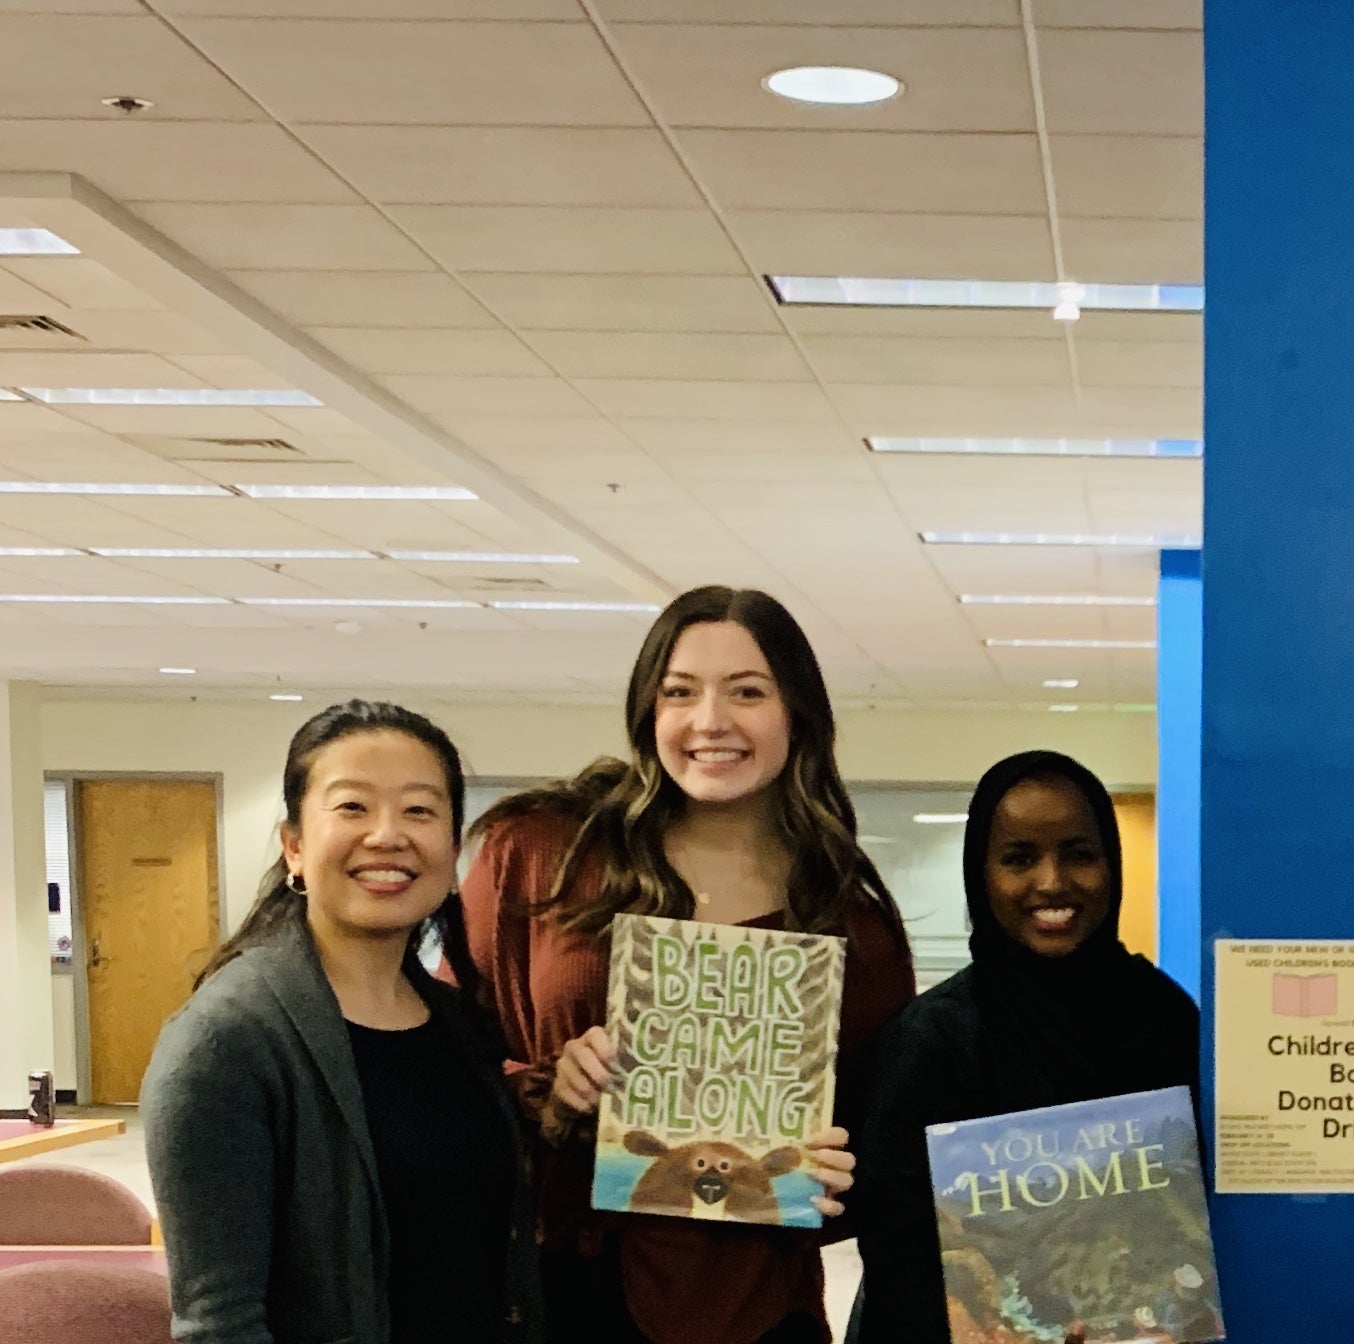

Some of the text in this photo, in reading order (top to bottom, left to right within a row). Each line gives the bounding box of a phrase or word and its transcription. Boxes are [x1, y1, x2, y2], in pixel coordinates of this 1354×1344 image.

[652, 934, 806, 1019] BEAR
[632, 1007, 804, 1080] CAME
[623, 1066, 808, 1140] ALONG
[981, 1118, 1144, 1166] YOU ARE
[965, 1143, 1171, 1218] HOME
